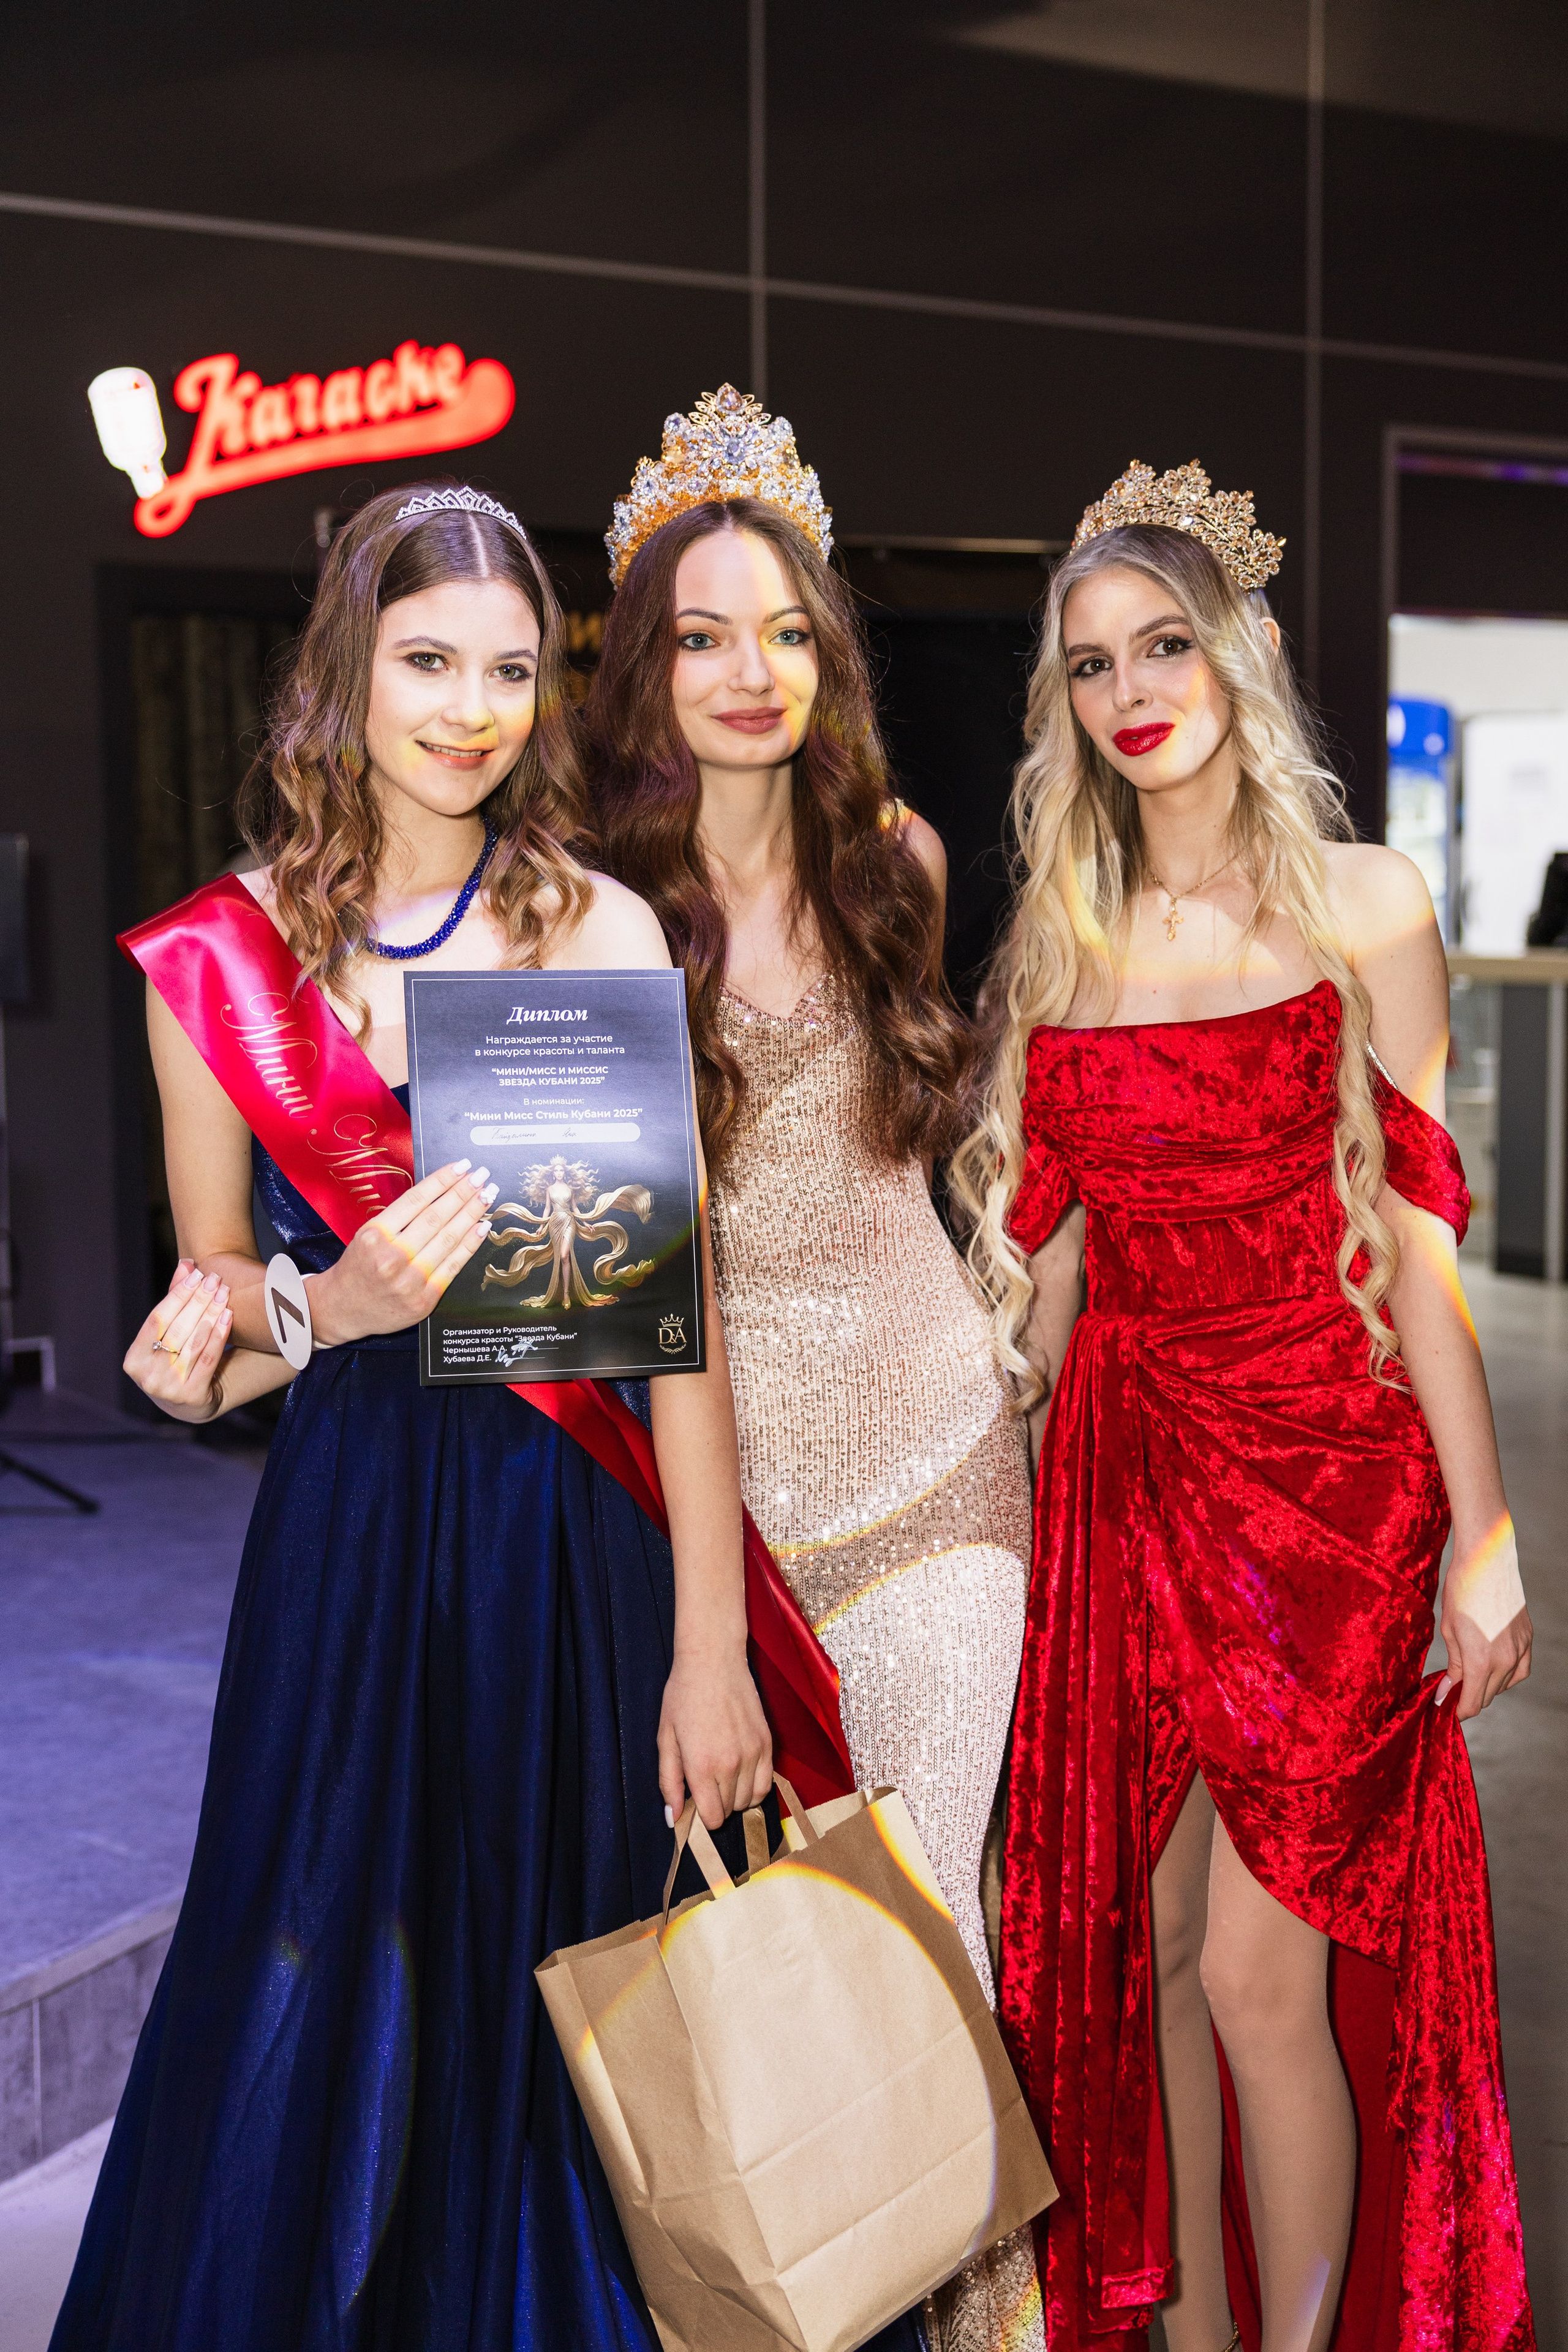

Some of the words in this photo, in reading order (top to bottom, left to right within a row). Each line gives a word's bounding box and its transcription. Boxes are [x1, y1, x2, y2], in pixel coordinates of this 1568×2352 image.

[173, 340, 469, 473] Karaoke
[506, 1006, 588, 1025] Диплом
[486, 1036, 558, 1046] Награждается
[573, 1035, 613, 1045] участие
[221, 992, 318, 1118] Мини
[483, 1048, 531, 1057] конкурсе
[533, 1047, 575, 1057] красоты
[491, 1066, 557, 1077] “МИНИ/МИСС
[559, 1066, 565, 1075] И
[568, 1066, 609, 1075] МИССИС
[499, 1078, 537, 1087] ЗВЕЗДА
[539, 1077, 578, 1086] КУБАНИ
[580, 1076, 605, 1085] 2025”
[532, 1097, 585, 1106] номинации:
[464, 1111, 502, 1121] “Мини
[504, 1111, 533, 1120] Мисс
[535, 1110, 568, 1120] Стиль
[571, 1109, 611, 1121] Кубани
[613, 1108, 643, 1118] 2025”
[443, 1328, 494, 1336] Организатор
[503, 1325, 557, 1335] Руководитель
[658, 1327, 687, 1344] D&A
[443, 1338, 480, 1346] конкурса
[481, 1336, 513, 1344] красоты
[546, 1332, 578, 1343] Кубани”
[443, 1346, 490, 1355] Чернышева
[443, 1355, 475, 1364] Хубаева
